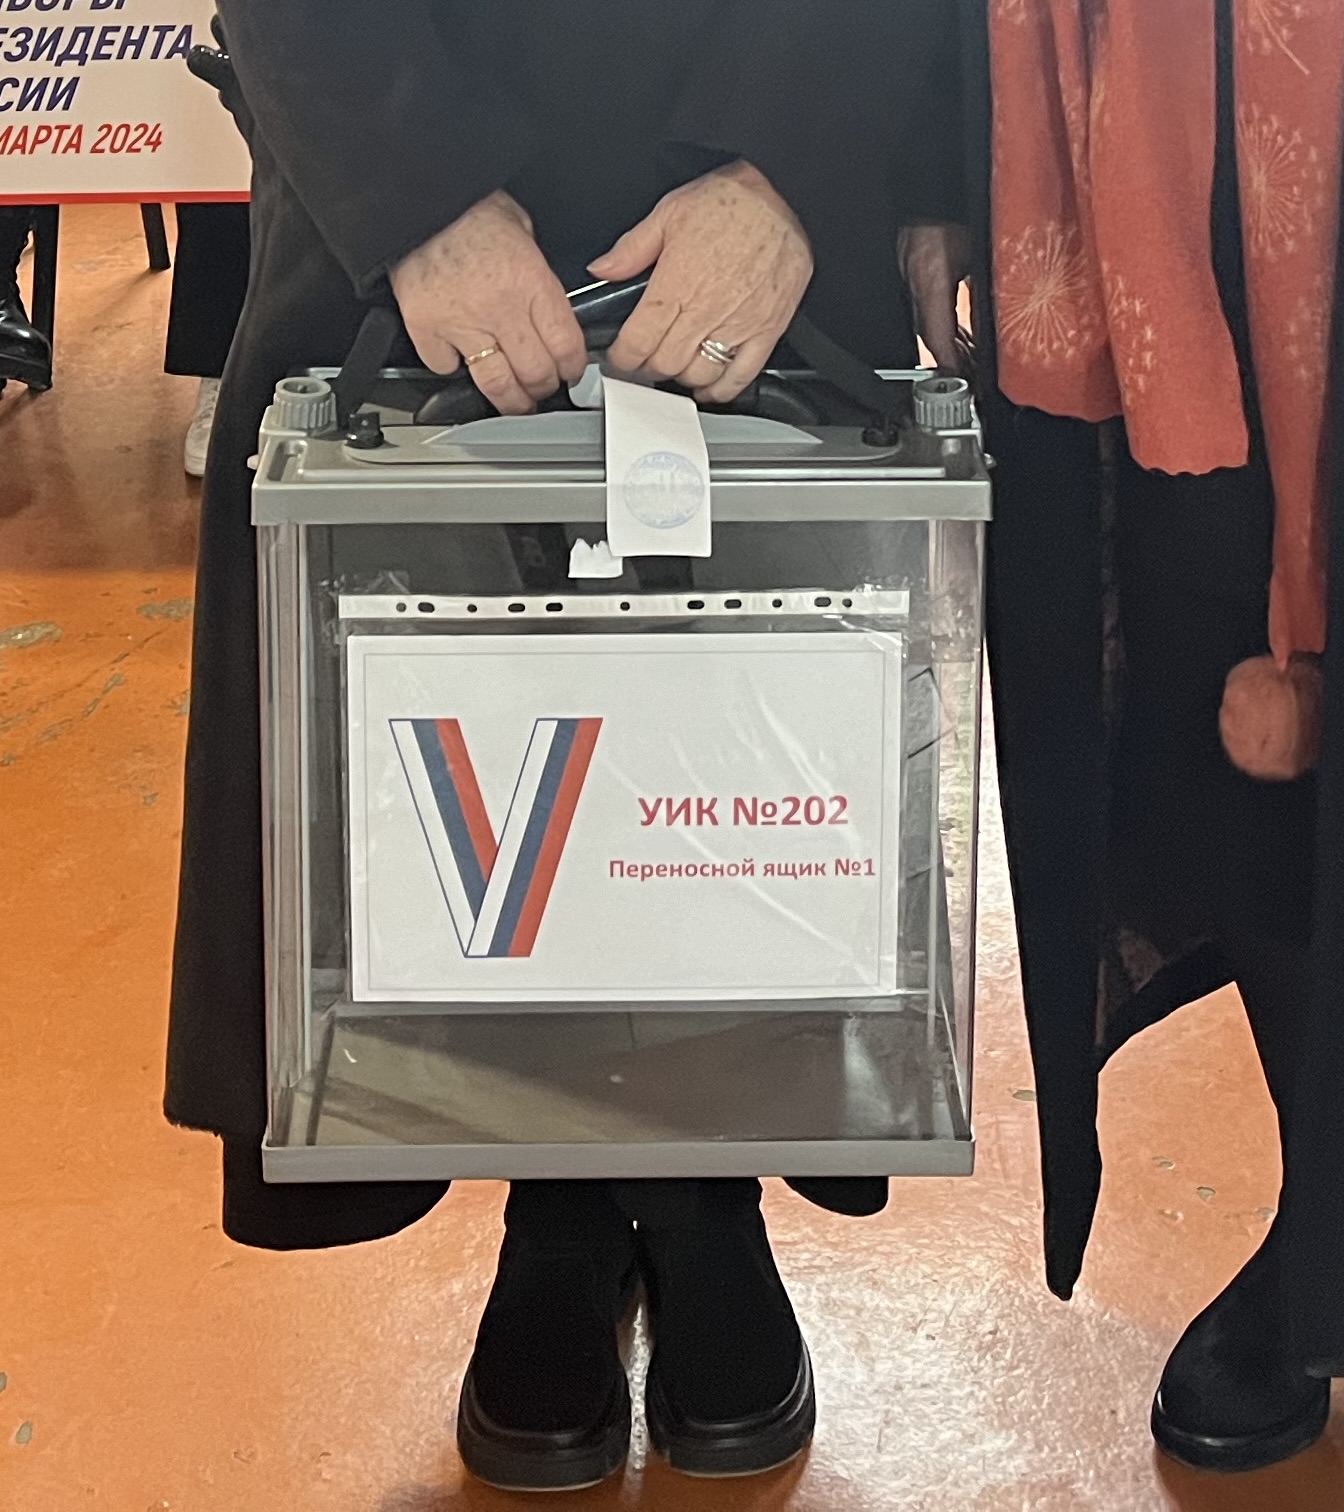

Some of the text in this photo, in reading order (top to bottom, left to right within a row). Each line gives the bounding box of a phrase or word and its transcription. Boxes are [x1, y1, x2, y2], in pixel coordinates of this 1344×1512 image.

[90, 122, 164, 155] 2024
[637, 794, 849, 827] УИК №202
[609, 858, 876, 881] Переносной ящик №1
